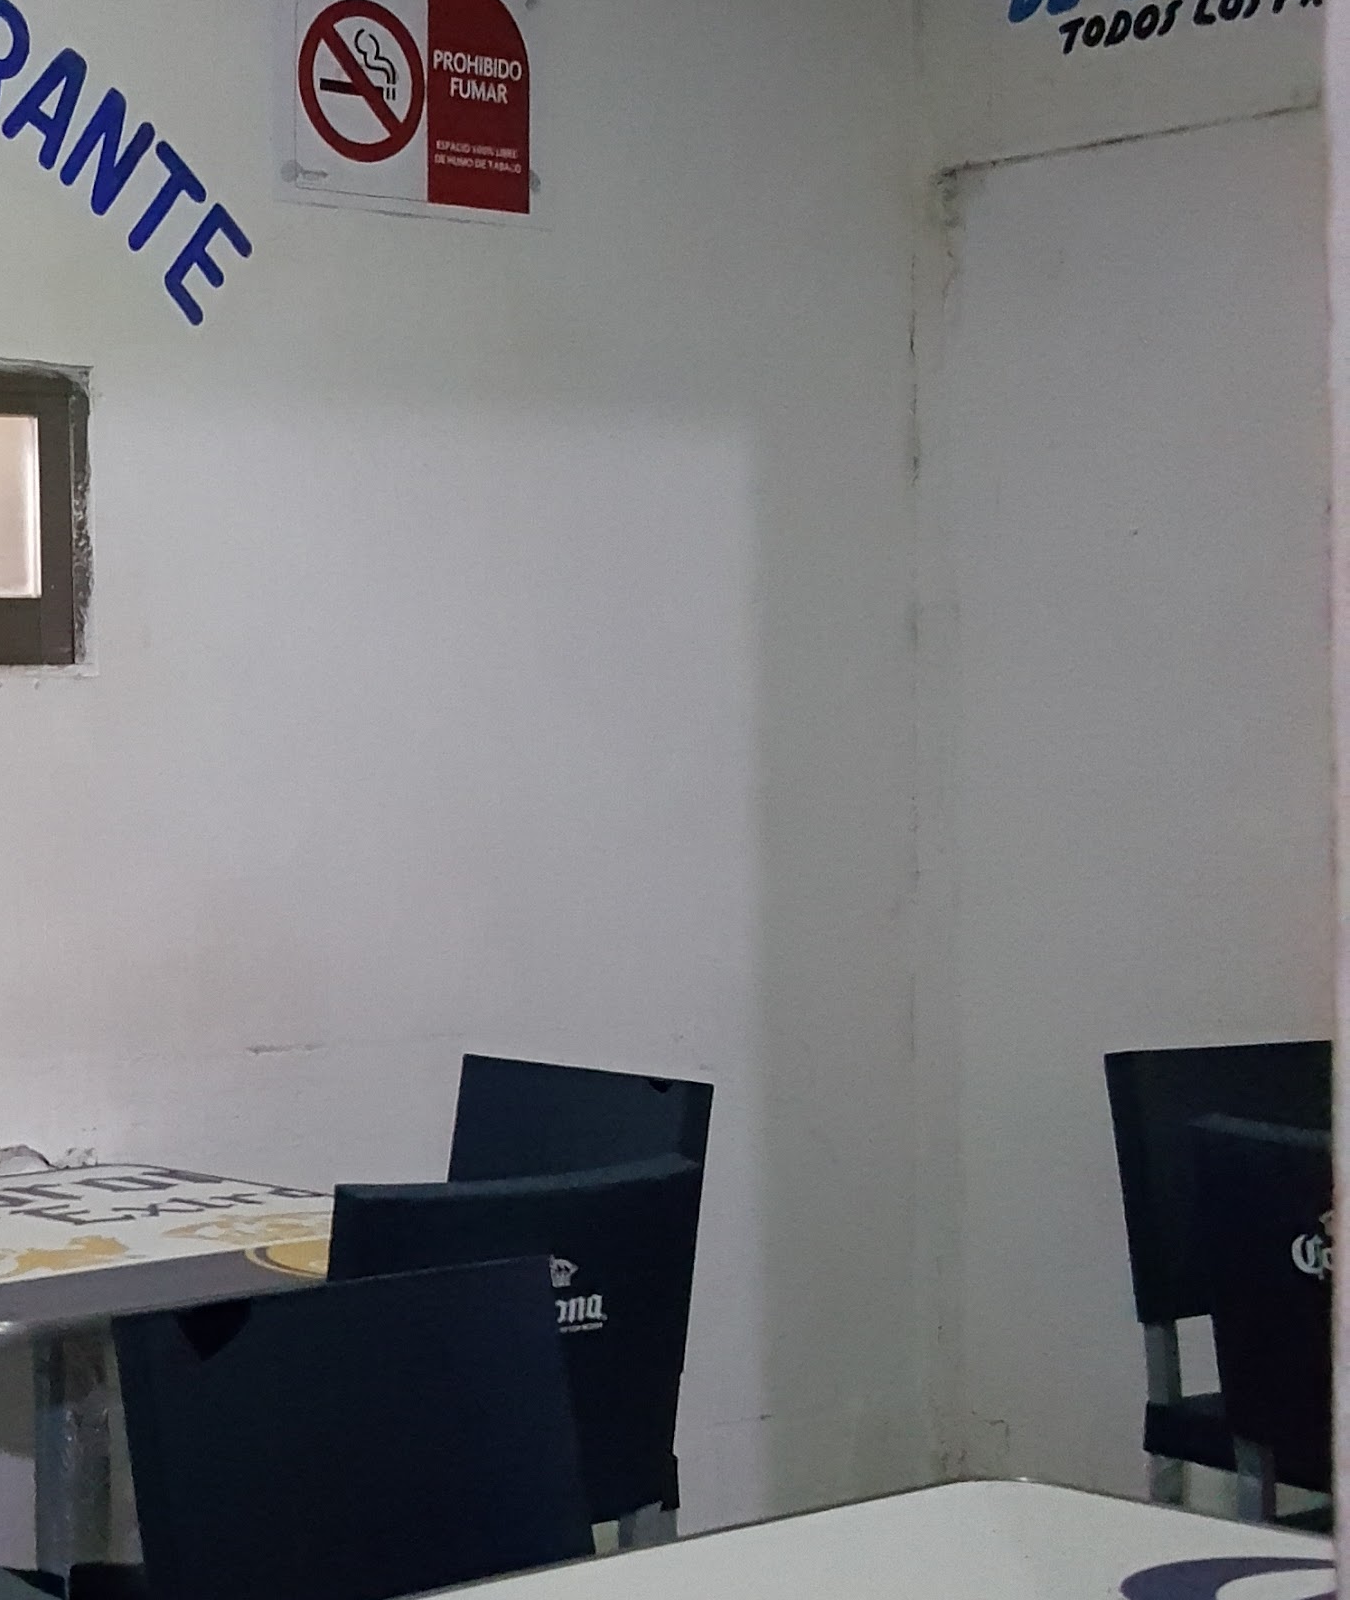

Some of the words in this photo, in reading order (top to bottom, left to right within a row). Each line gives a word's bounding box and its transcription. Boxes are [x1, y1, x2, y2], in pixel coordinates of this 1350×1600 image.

[1059, 0, 1183, 55] TODOS
[433, 49, 523, 81] PROHIBIDO
[450, 77, 508, 104] FUMAR
